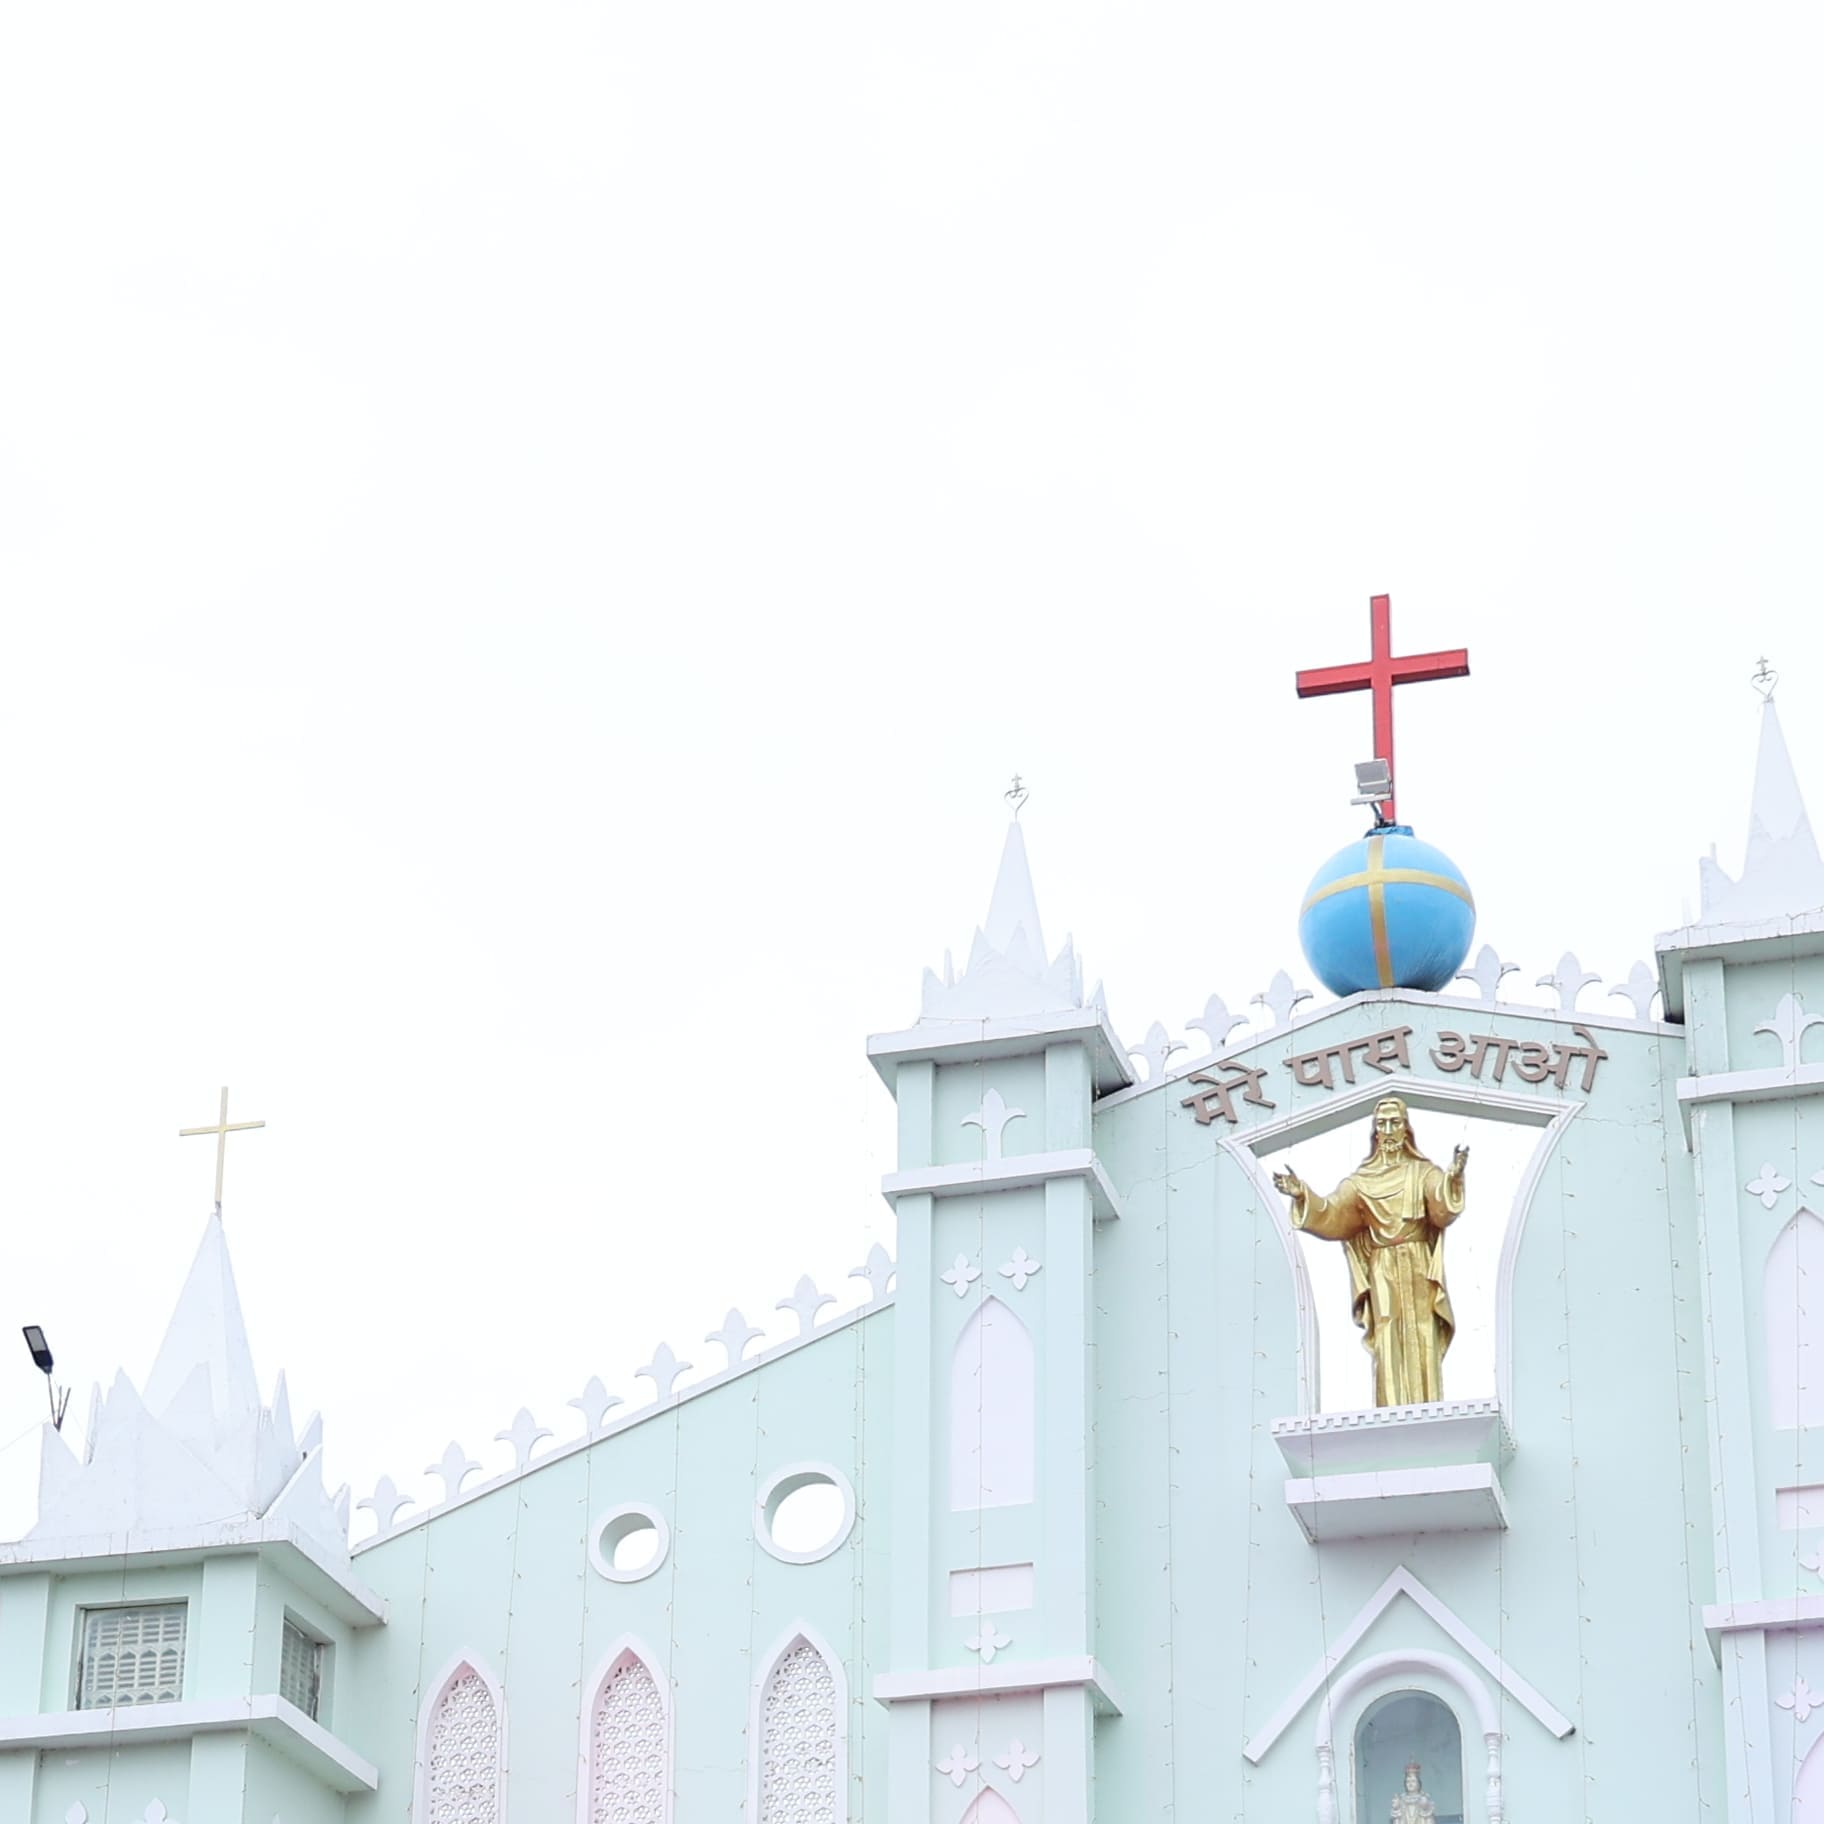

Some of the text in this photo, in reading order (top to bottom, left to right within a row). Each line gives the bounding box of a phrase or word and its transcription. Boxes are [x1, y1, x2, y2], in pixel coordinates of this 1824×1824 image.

[1181, 1025, 1609, 1126] मेरे पास आओ
